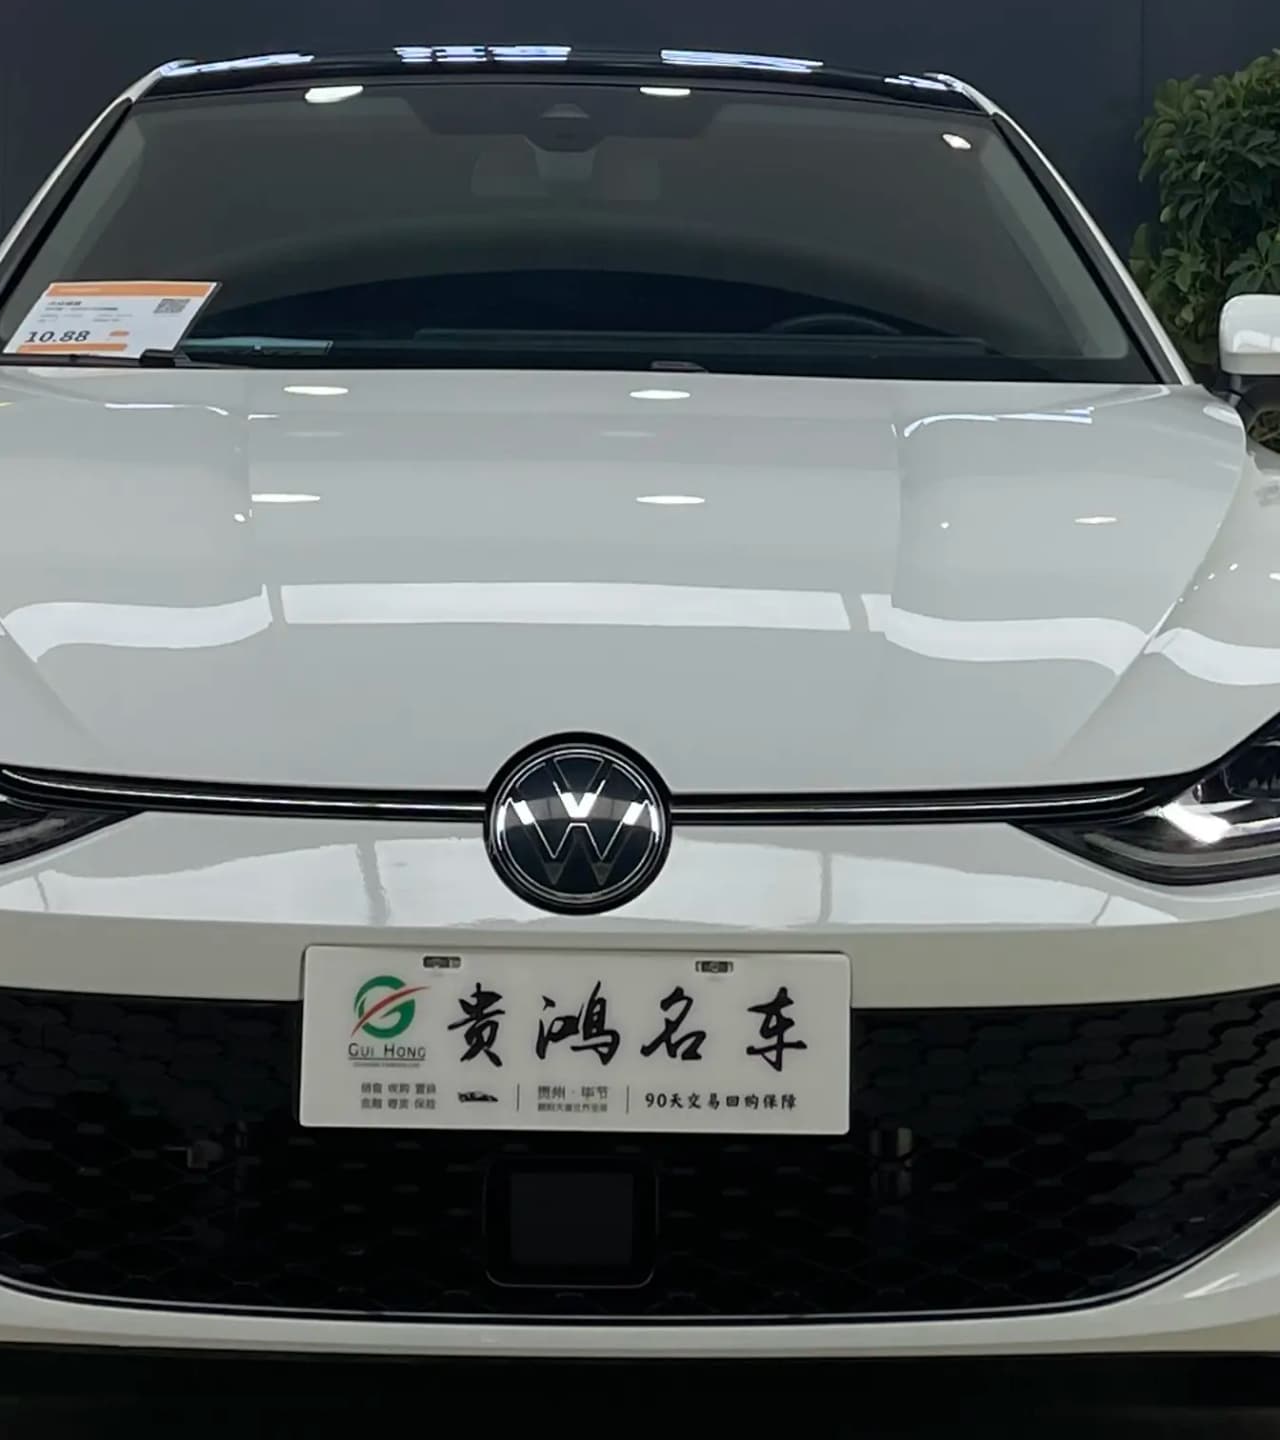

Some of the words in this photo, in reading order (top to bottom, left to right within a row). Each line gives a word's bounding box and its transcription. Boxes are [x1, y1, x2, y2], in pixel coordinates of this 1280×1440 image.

[24, 329, 91, 343] 10.88
[448, 981, 808, 1071] 贵鸿名车
[644, 1092, 797, 1110] 90天交易回购保障
